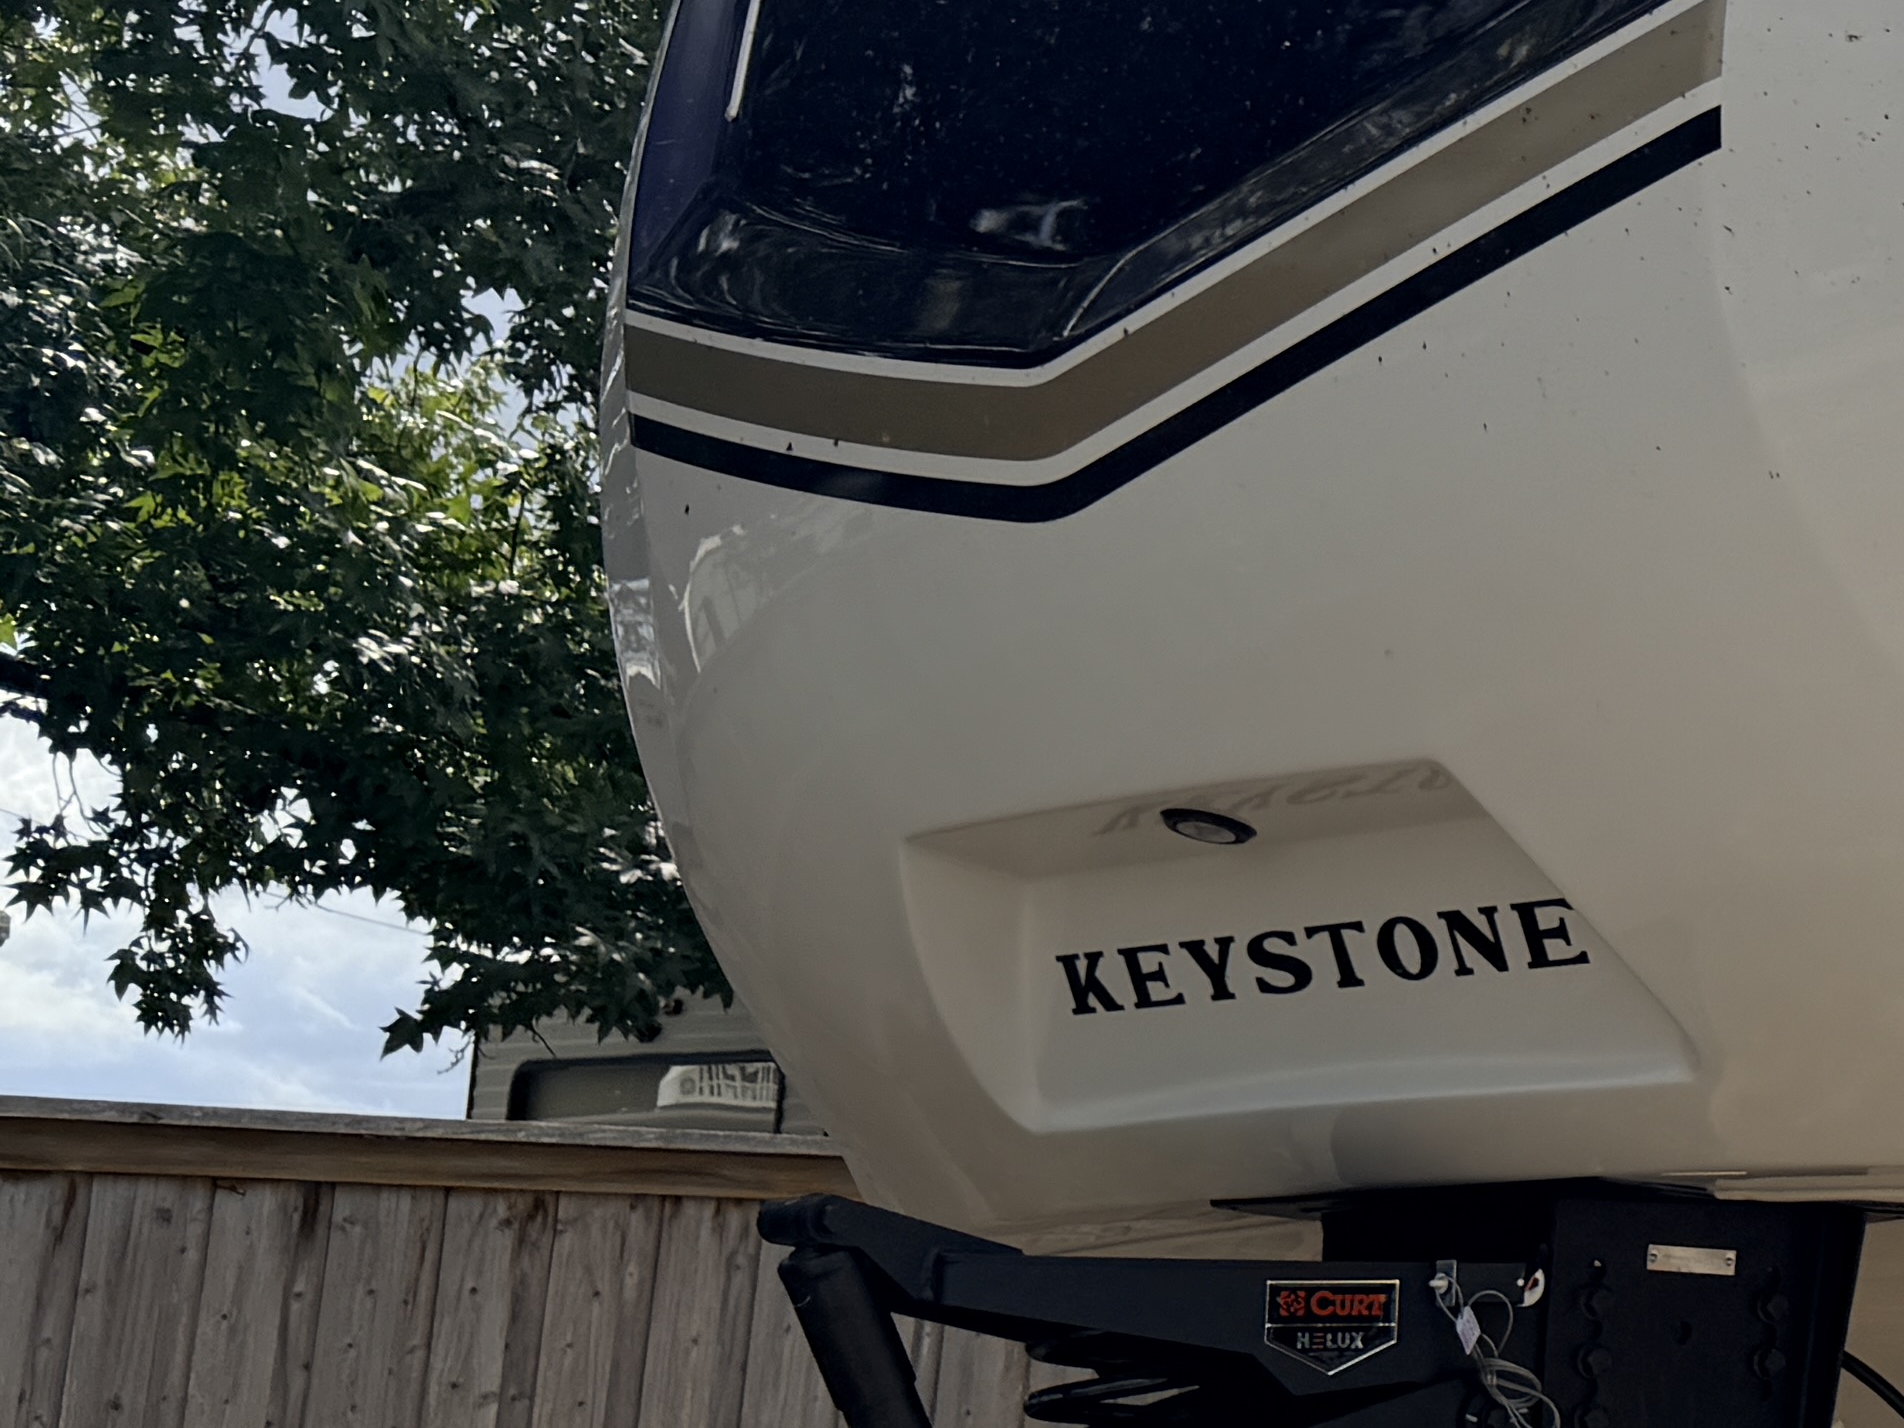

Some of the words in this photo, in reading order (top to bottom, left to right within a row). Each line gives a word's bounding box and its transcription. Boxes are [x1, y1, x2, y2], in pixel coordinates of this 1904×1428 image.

[1055, 897, 1591, 1016] KEYSTONE
[1310, 1290, 1388, 1316] CURT
[1296, 1332, 1364, 1349] HELUX
